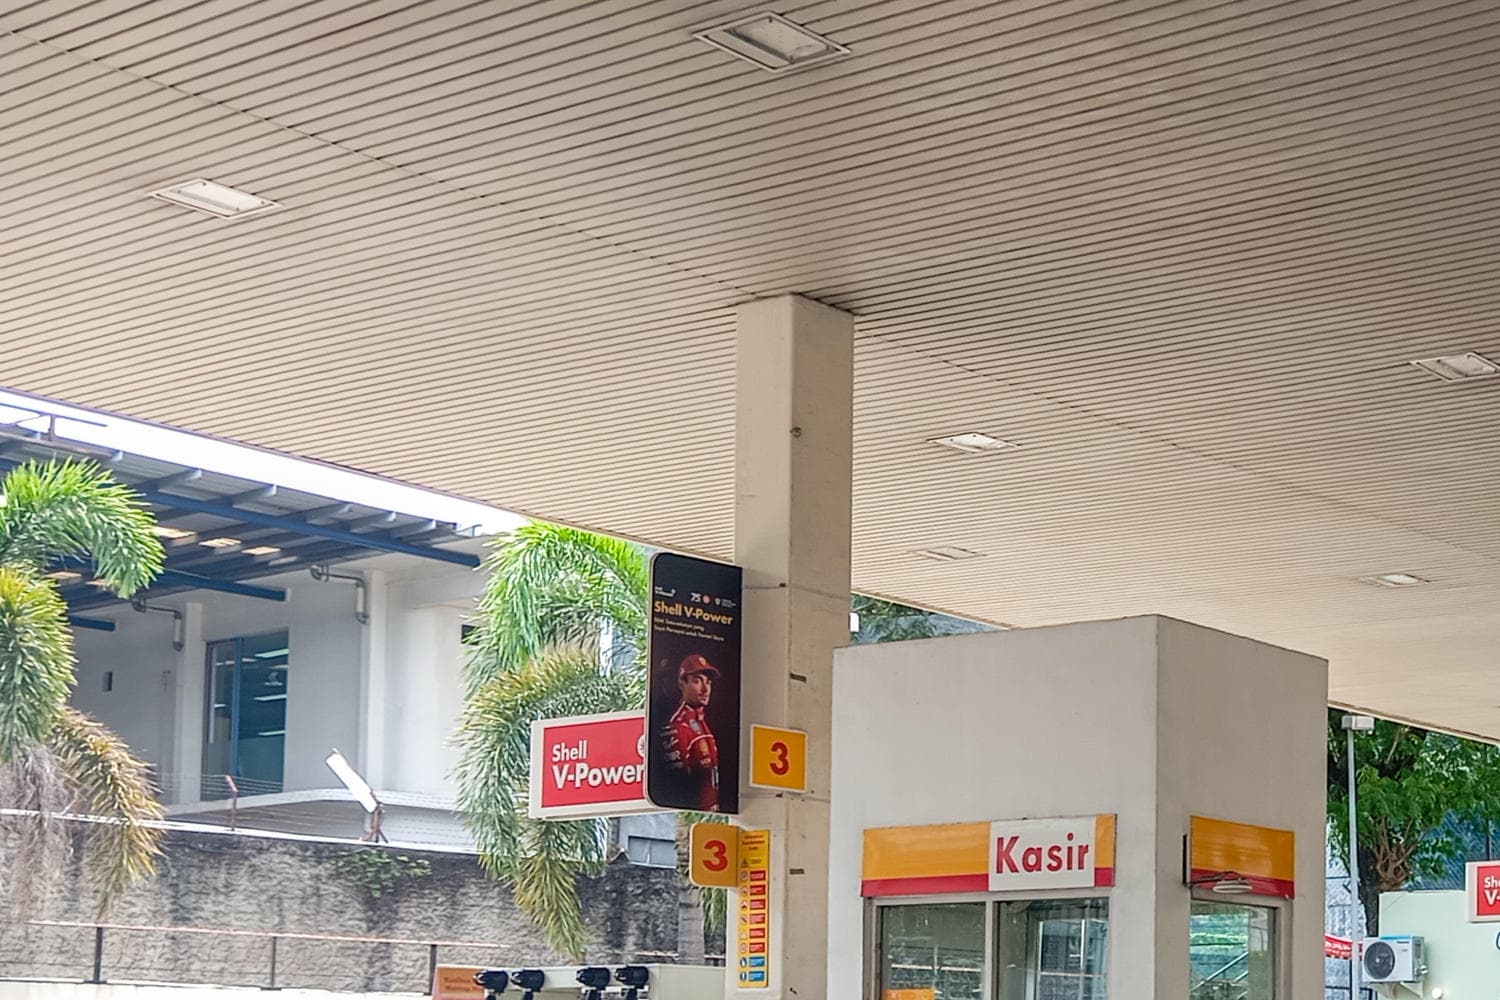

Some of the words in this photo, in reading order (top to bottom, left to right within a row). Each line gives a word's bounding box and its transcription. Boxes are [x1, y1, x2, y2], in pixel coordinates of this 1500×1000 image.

[654, 600, 682, 617] Shell
[684, 605, 734, 625] V-Power
[551, 739, 588, 762] Shell
[769, 741, 790, 776] 3
[552, 762, 645, 789] V-Power
[702, 839, 729, 872] 3
[996, 832, 1089, 874] Kasir
